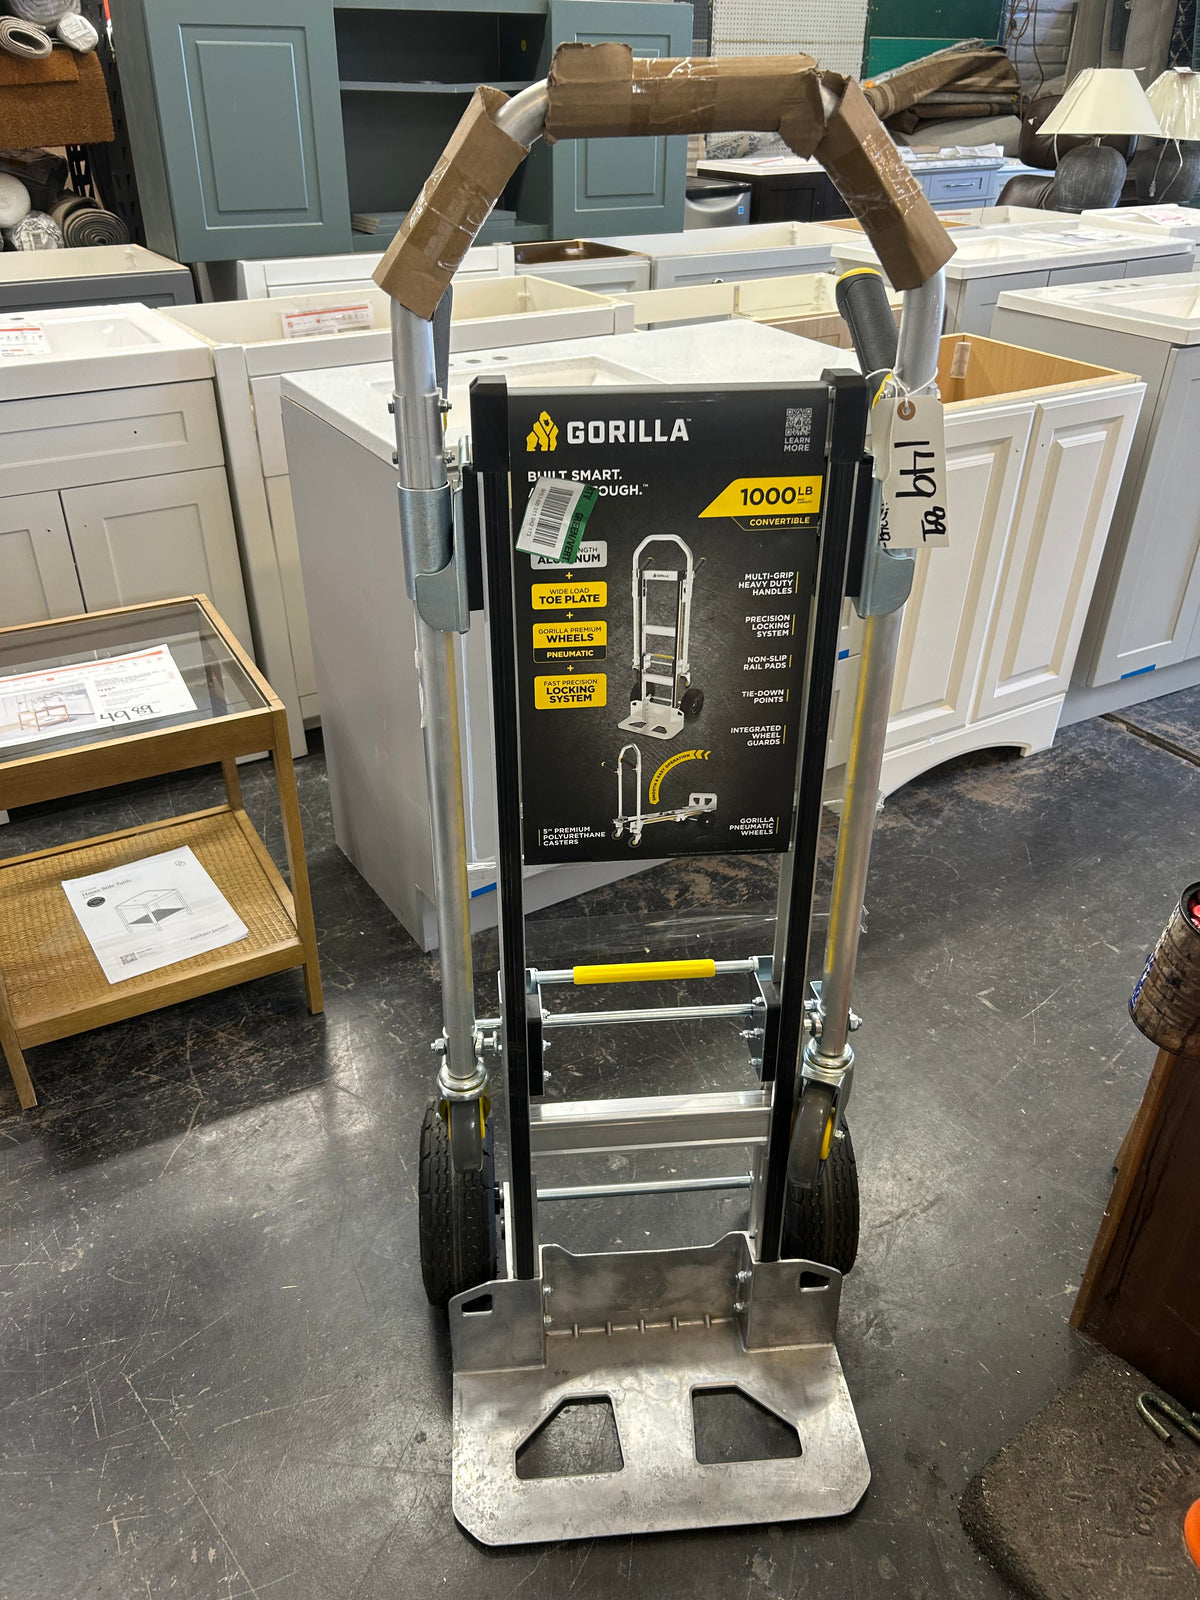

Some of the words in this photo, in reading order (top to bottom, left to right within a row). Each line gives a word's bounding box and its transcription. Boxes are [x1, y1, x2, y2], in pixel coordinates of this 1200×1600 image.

[784, 444, 810, 452] MORE
[571, 469, 622, 481] SMART.
[740, 486, 796, 506] 1000
[798, 486, 813, 496] LB
[749, 516, 810, 527] CONVERTIBLE
[745, 571, 794, 580] MULTI-GRIP
[738, 580, 768, 589] HEAVY
[770, 579, 793, 588] DUTY
[570, 587, 589, 595] LOAD
[752, 587, 793, 596] HANDLES
[539, 595, 562, 605] TOE
[565, 594, 600, 604] PLATE
[745, 614, 790, 623] PRECISION
[538, 627, 568, 635] GORILLA
[752, 622, 789, 631] LOCKING
[546, 633, 594, 643] WHEELS
[756, 629, 789, 638] SYSTEM
[546, 649, 594, 659] PNEUMATIC
[747, 654, 787, 663] NON-SLIP
[743, 663, 763, 671] RAIL
[764, 662, 786, 670] PADS
[546, 685, 595, 695] LOCKING
[741, 689, 784, 698] TIE-DOWN
[549, 694, 592, 704] SYSTEM
[753, 696, 784, 704] POINTS
[100, 710, 131, 722] 49
[730, 725, 781, 734] INTEGRATED
[752, 731, 781, 739] WHEEL
[747, 738, 780, 746] GUARDS
[740, 816, 774, 824] GORILLA
[554, 826, 591, 834] PREMIUM
[729, 822, 774, 831] PNEUMATIC
[543, 831, 606, 841] POLYURETHANE
